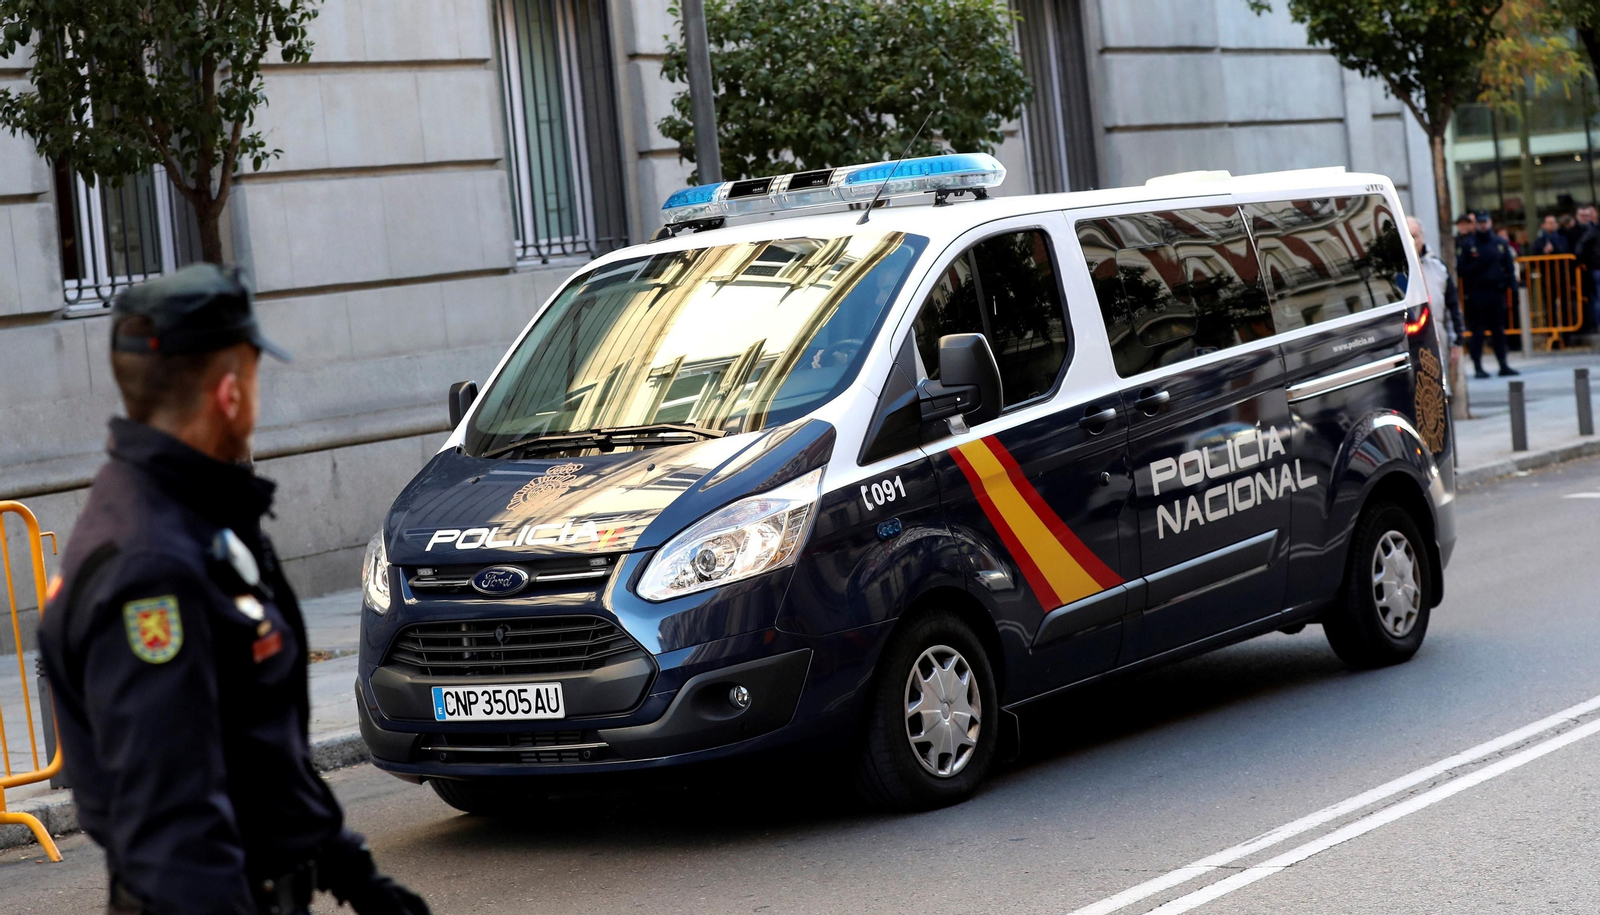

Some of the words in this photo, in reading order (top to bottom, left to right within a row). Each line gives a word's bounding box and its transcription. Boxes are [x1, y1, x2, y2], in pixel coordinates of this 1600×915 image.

[1150, 420, 1286, 496] POLICÍA
[871, 475, 907, 506] 091
[1156, 458, 1318, 539] NACIONAL
[425, 518, 598, 551] POLICÍA
[481, 571, 512, 588] Ford
